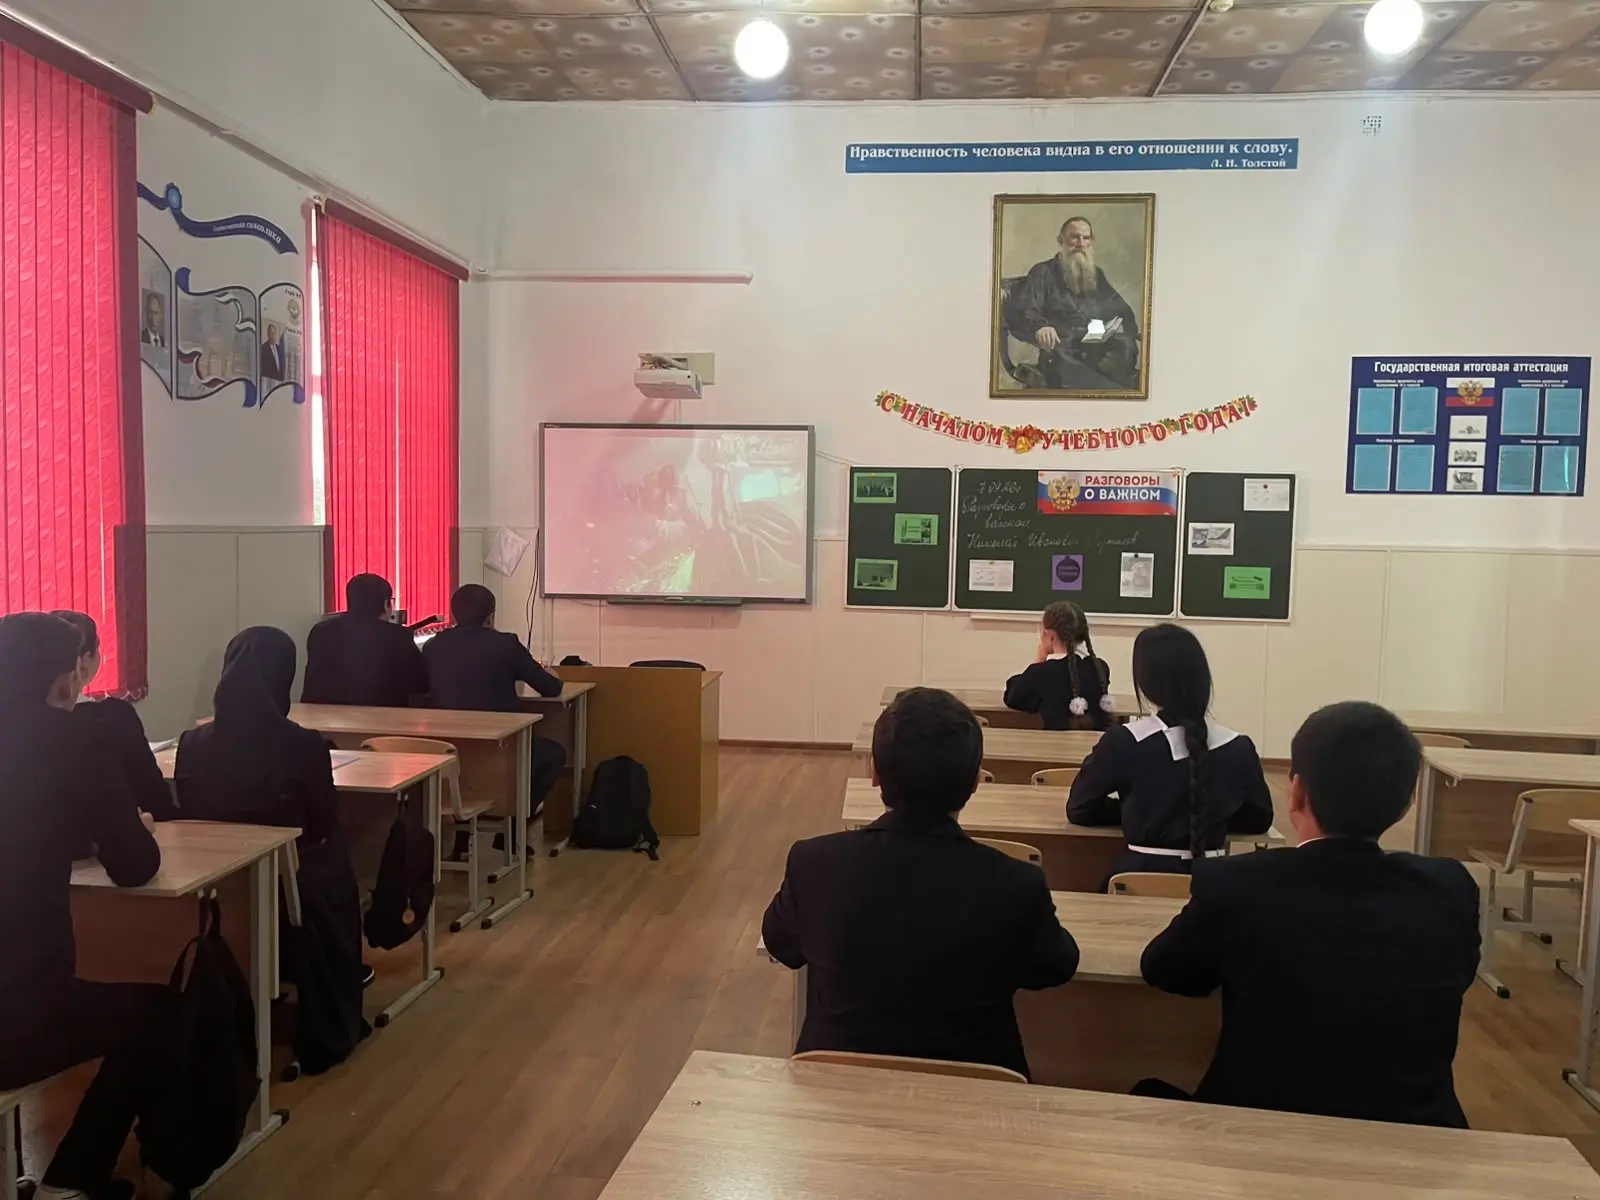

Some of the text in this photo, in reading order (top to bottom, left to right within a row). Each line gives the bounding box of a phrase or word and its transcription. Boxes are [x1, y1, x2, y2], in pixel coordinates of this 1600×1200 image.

[850, 143, 1292, 161] Нравственность человека видна в его отношении к слову.
[1226, 159, 1238, 167] Н.
[1241, 158, 1286, 167] Толстой
[1374, 361, 1568, 373] Государственная итоговая аттестация
[880, 394, 1254, 450] С НАЧАЛОМ УЧЕБНОГО ГОДА!
[1085, 475, 1160, 486] РАЗГОВОРЫ
[1084, 488, 1160, 500] О ВАЖНОМ
